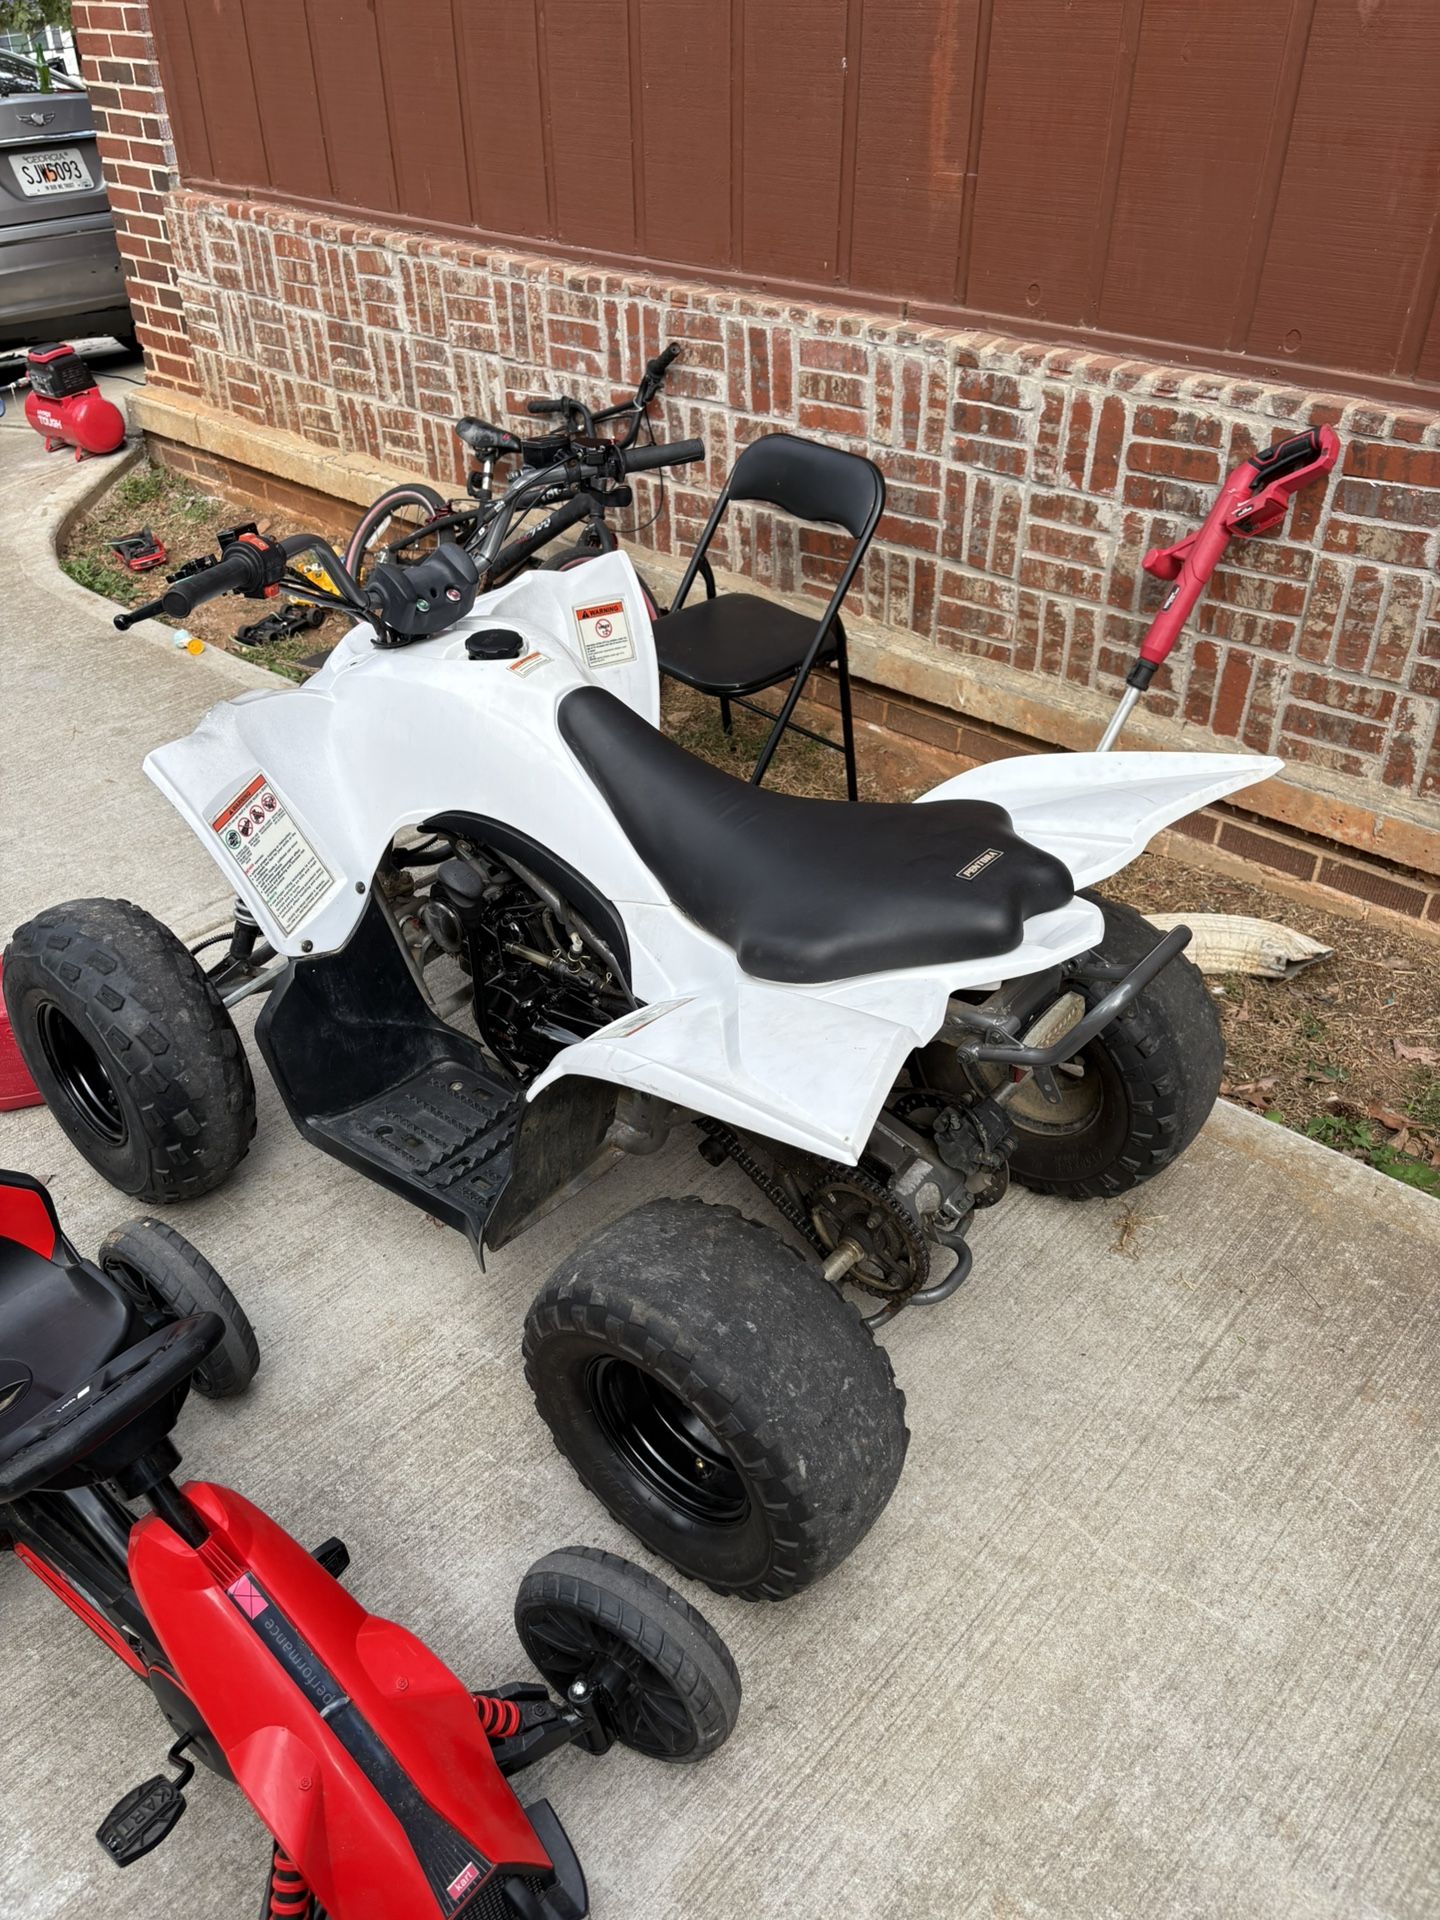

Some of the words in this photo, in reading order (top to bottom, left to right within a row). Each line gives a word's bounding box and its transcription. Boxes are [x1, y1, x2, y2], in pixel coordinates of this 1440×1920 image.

[25, 153, 67, 164] GEORGIA
[21, 160, 82, 185] SJW5093
[37, 415, 63, 430] TOUGH
[589, 605, 619, 616] WARNING
[264, 1618, 337, 1705] performance
[121, 1789, 171, 1837] KART
[454, 1871, 473, 1892] kart
